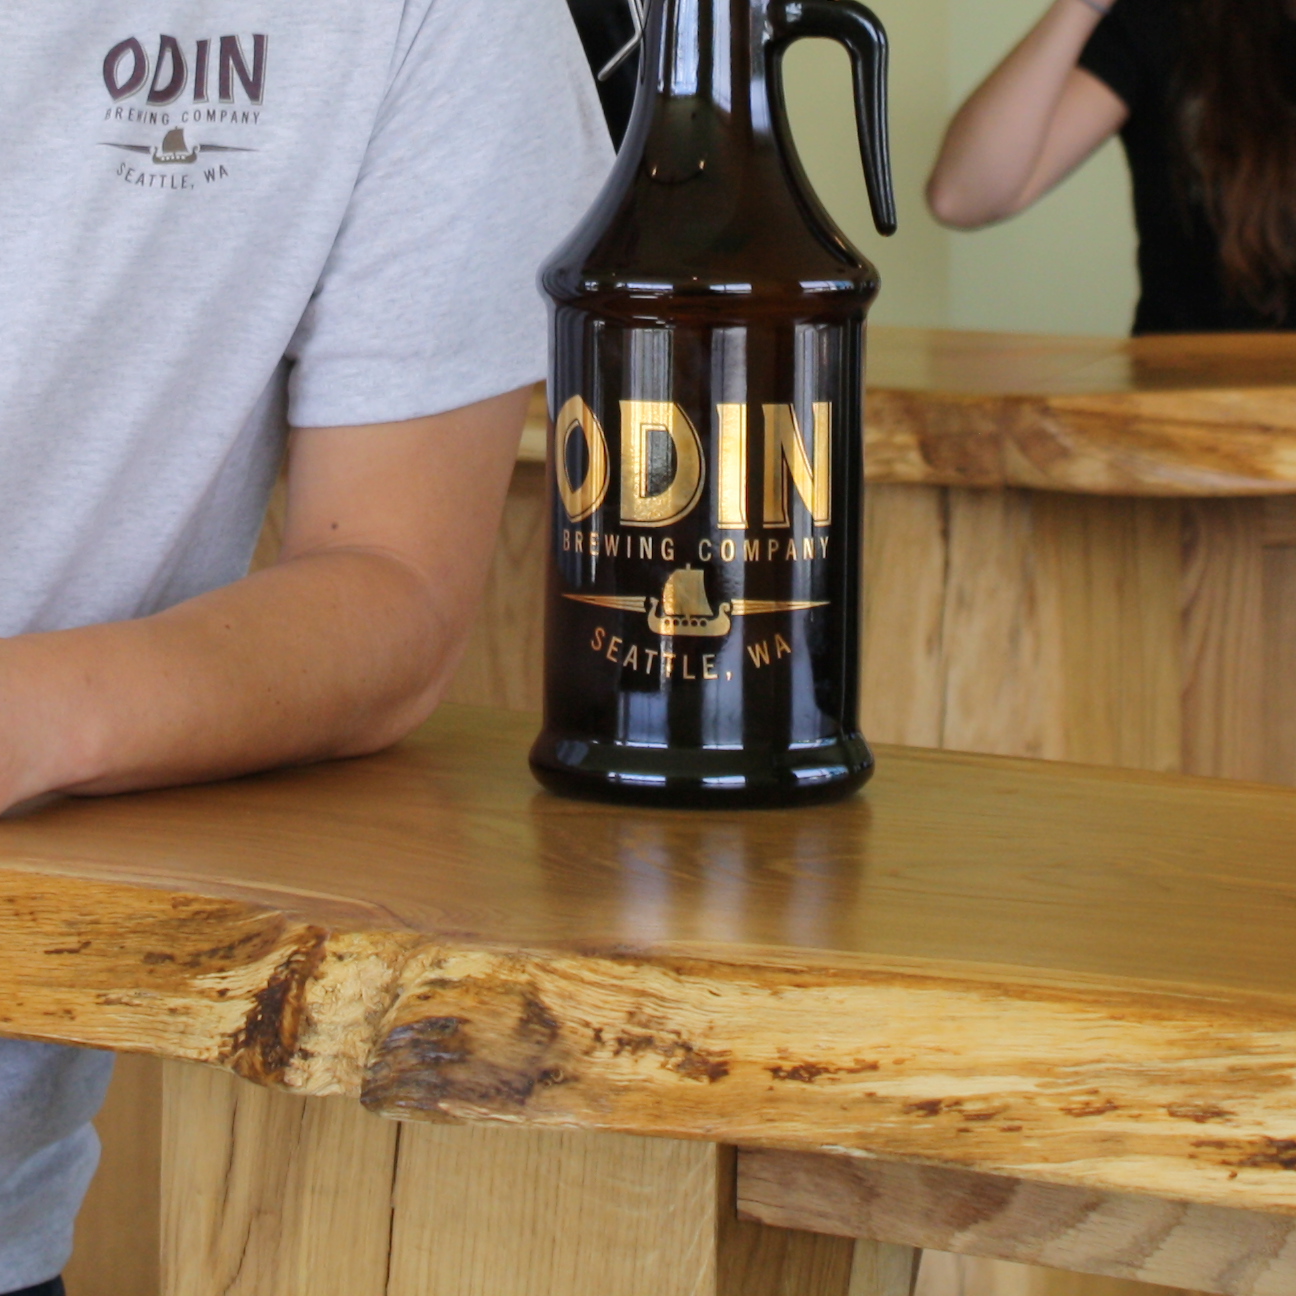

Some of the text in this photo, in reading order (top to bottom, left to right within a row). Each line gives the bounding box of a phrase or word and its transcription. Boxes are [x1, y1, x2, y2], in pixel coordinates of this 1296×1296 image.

[102, 33, 269, 106] ODIN
[105, 107, 261, 126] BREWING COMPANY
[116, 162, 229, 190] SEATTLE, WA
[555, 394, 833, 530] ODIN
[562, 529, 830, 563] BREWING COMPANY
[590, 626, 792, 682] SEATTLE, WA
